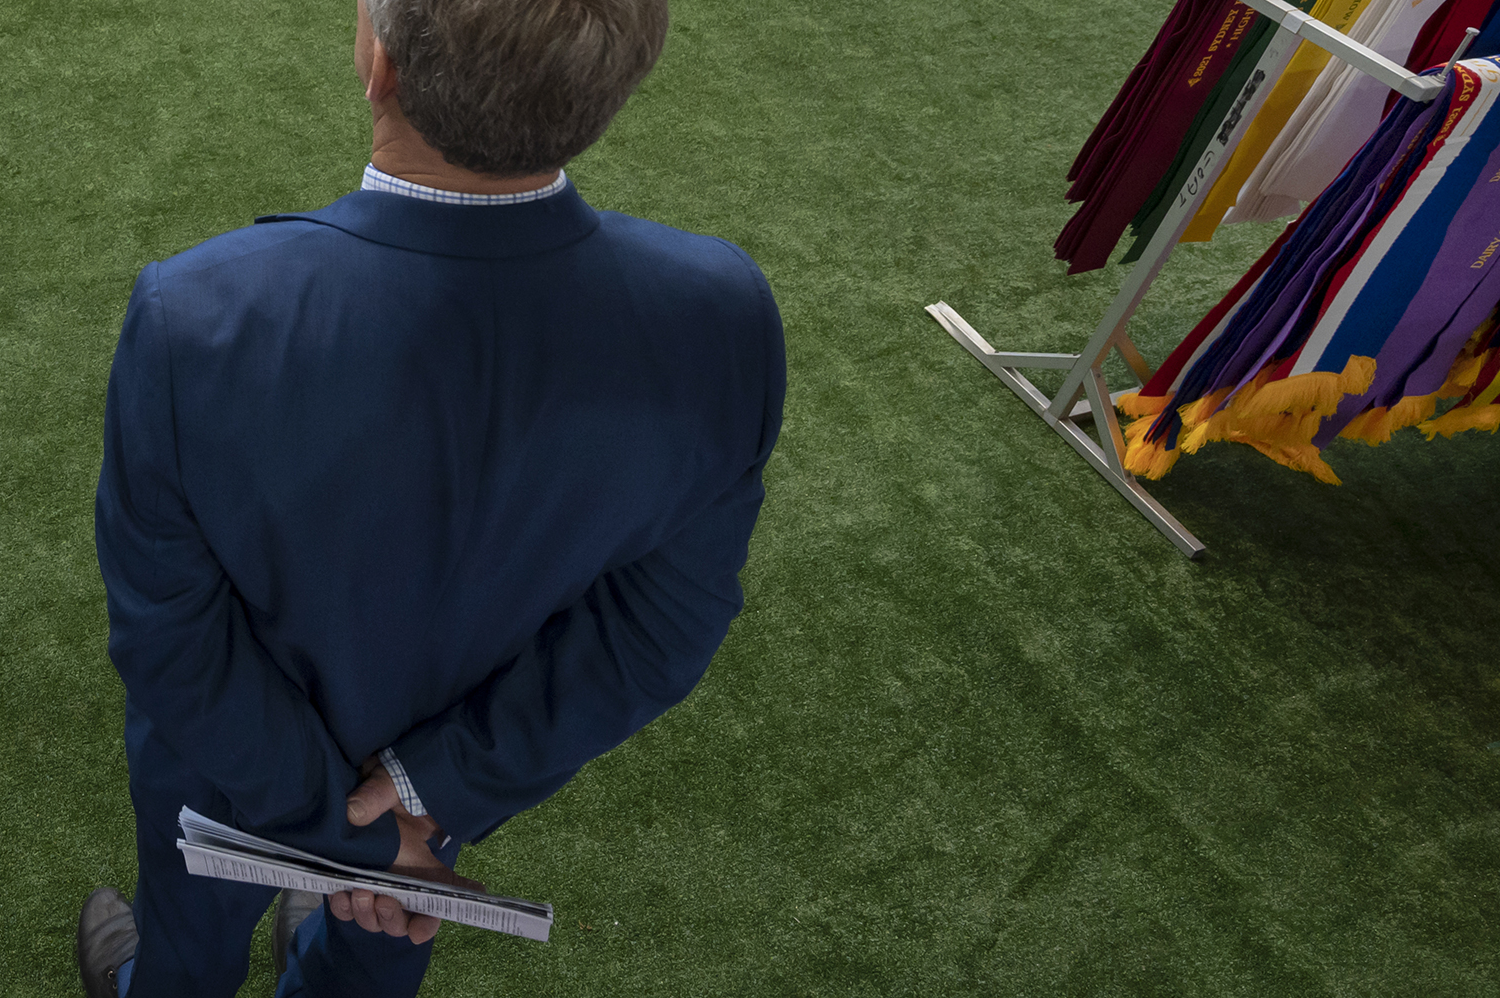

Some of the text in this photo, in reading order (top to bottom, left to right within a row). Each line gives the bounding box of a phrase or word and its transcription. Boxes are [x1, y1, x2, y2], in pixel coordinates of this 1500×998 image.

[1230, 9, 1254, 41] HIGH
[1194, 55, 1212, 78] 2021
[1208, 9, 1239, 52] SYDNEY
[1441, 106, 1463, 134] 2021
[1470, 237, 1500, 269] DAIRY
